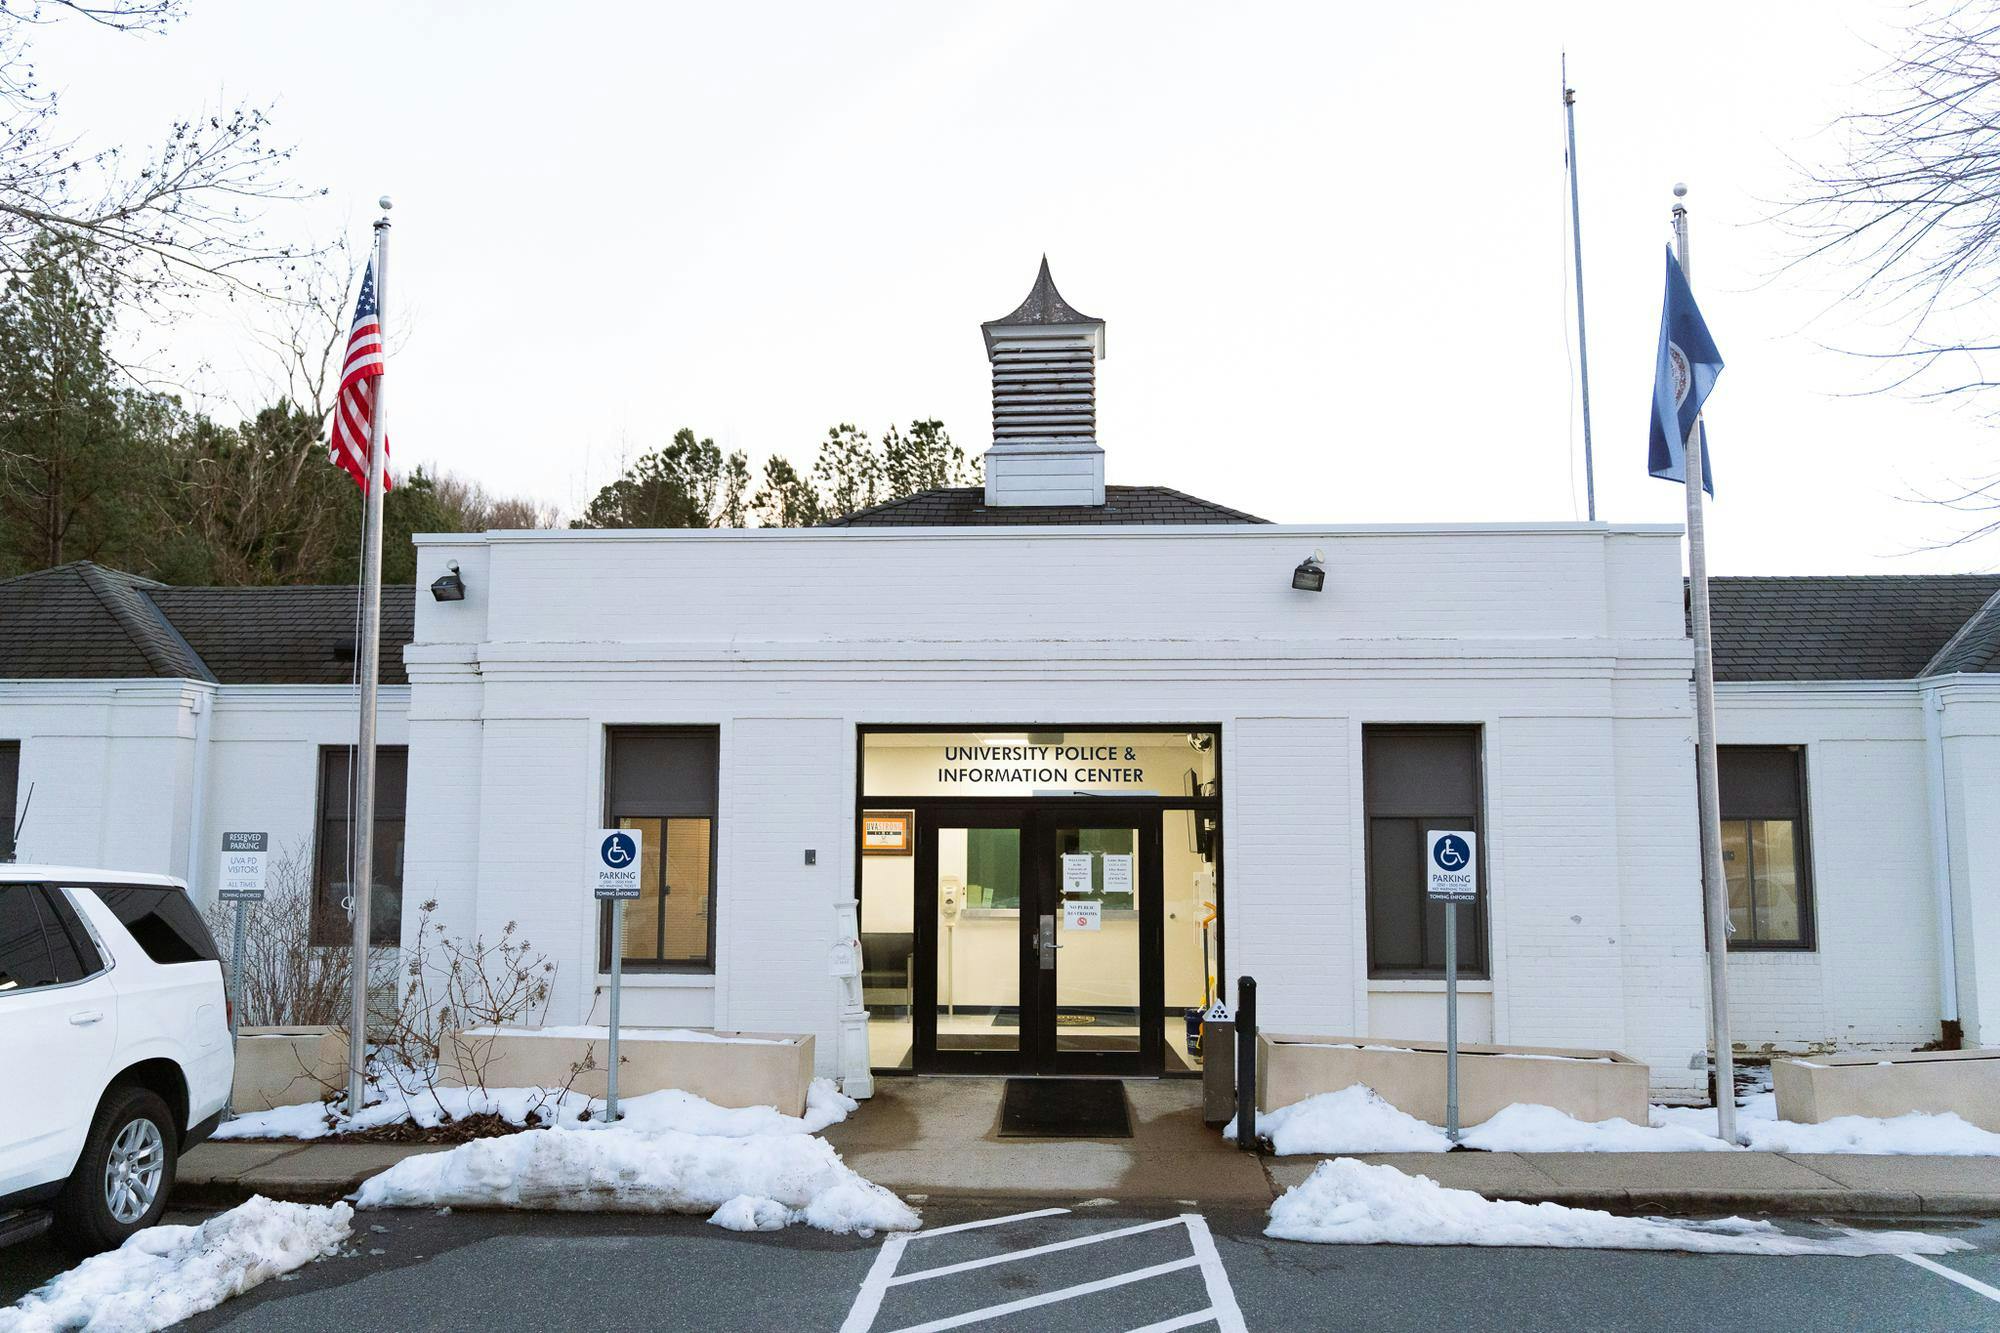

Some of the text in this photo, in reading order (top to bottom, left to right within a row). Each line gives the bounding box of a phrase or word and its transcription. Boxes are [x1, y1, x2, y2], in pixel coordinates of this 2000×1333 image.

[945, 746, 1136, 761] UNIVERSITY POLICE &
[938, 768, 1144, 782] INFORMATION CENTER
[230, 833, 262, 841] RESERVED
[230, 842, 260, 850] PARKING
[230, 857, 258, 865] UVA PD
[228, 865, 259, 873] VISITORS
[599, 871, 636, 880] PARKING
[1432, 874, 1471, 883] PARKING
